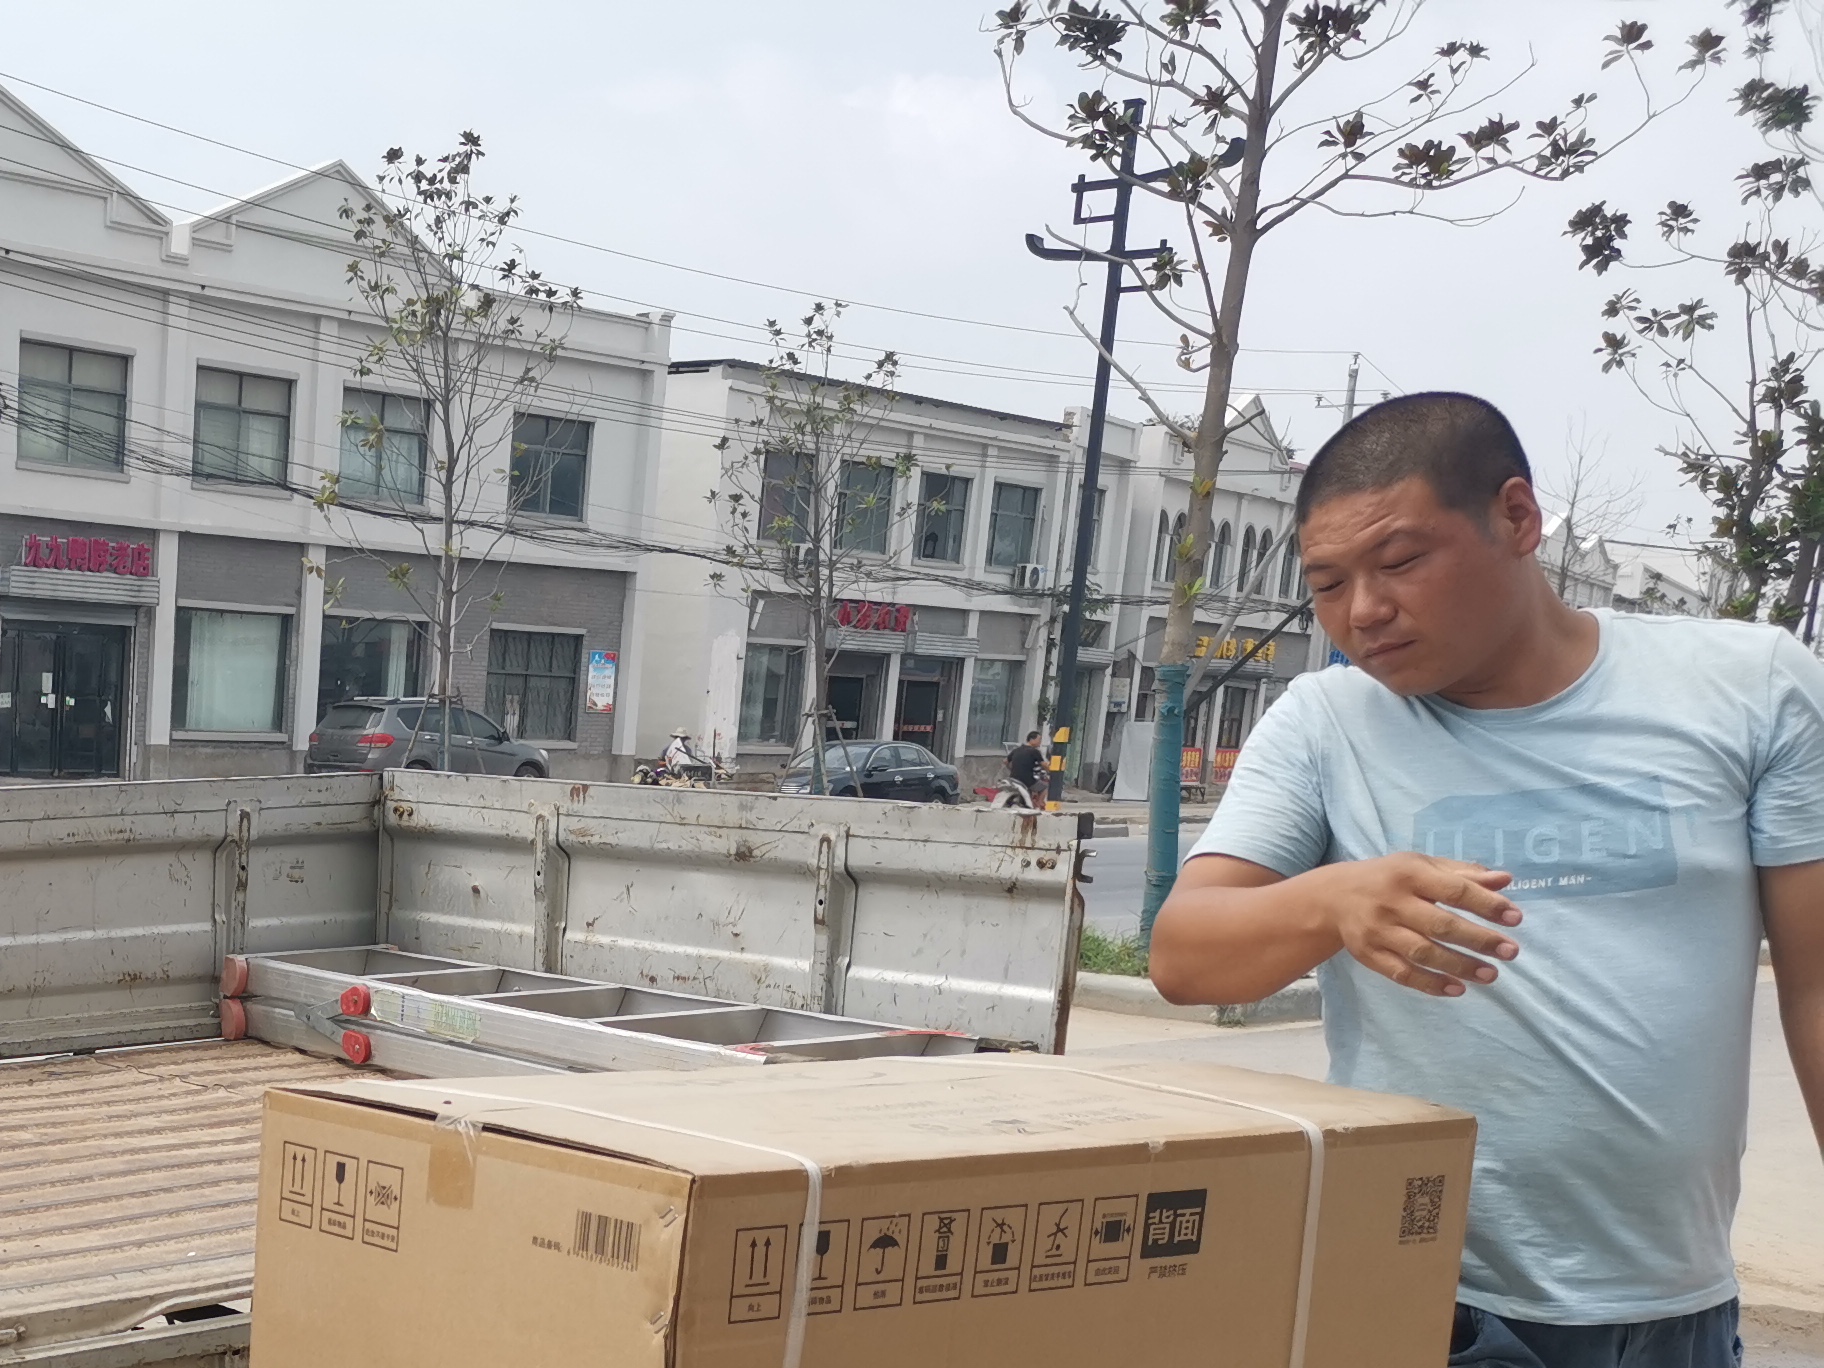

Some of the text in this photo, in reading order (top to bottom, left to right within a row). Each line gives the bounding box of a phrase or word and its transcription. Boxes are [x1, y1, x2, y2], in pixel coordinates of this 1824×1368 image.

[24, 533, 151, 577] 九九鸭脖老店
[1147, 1207, 1202, 1246] 背面
[1147, 1263, 1188, 1279] 严禁挤压
[747, 1302, 762, 1313] 向上
